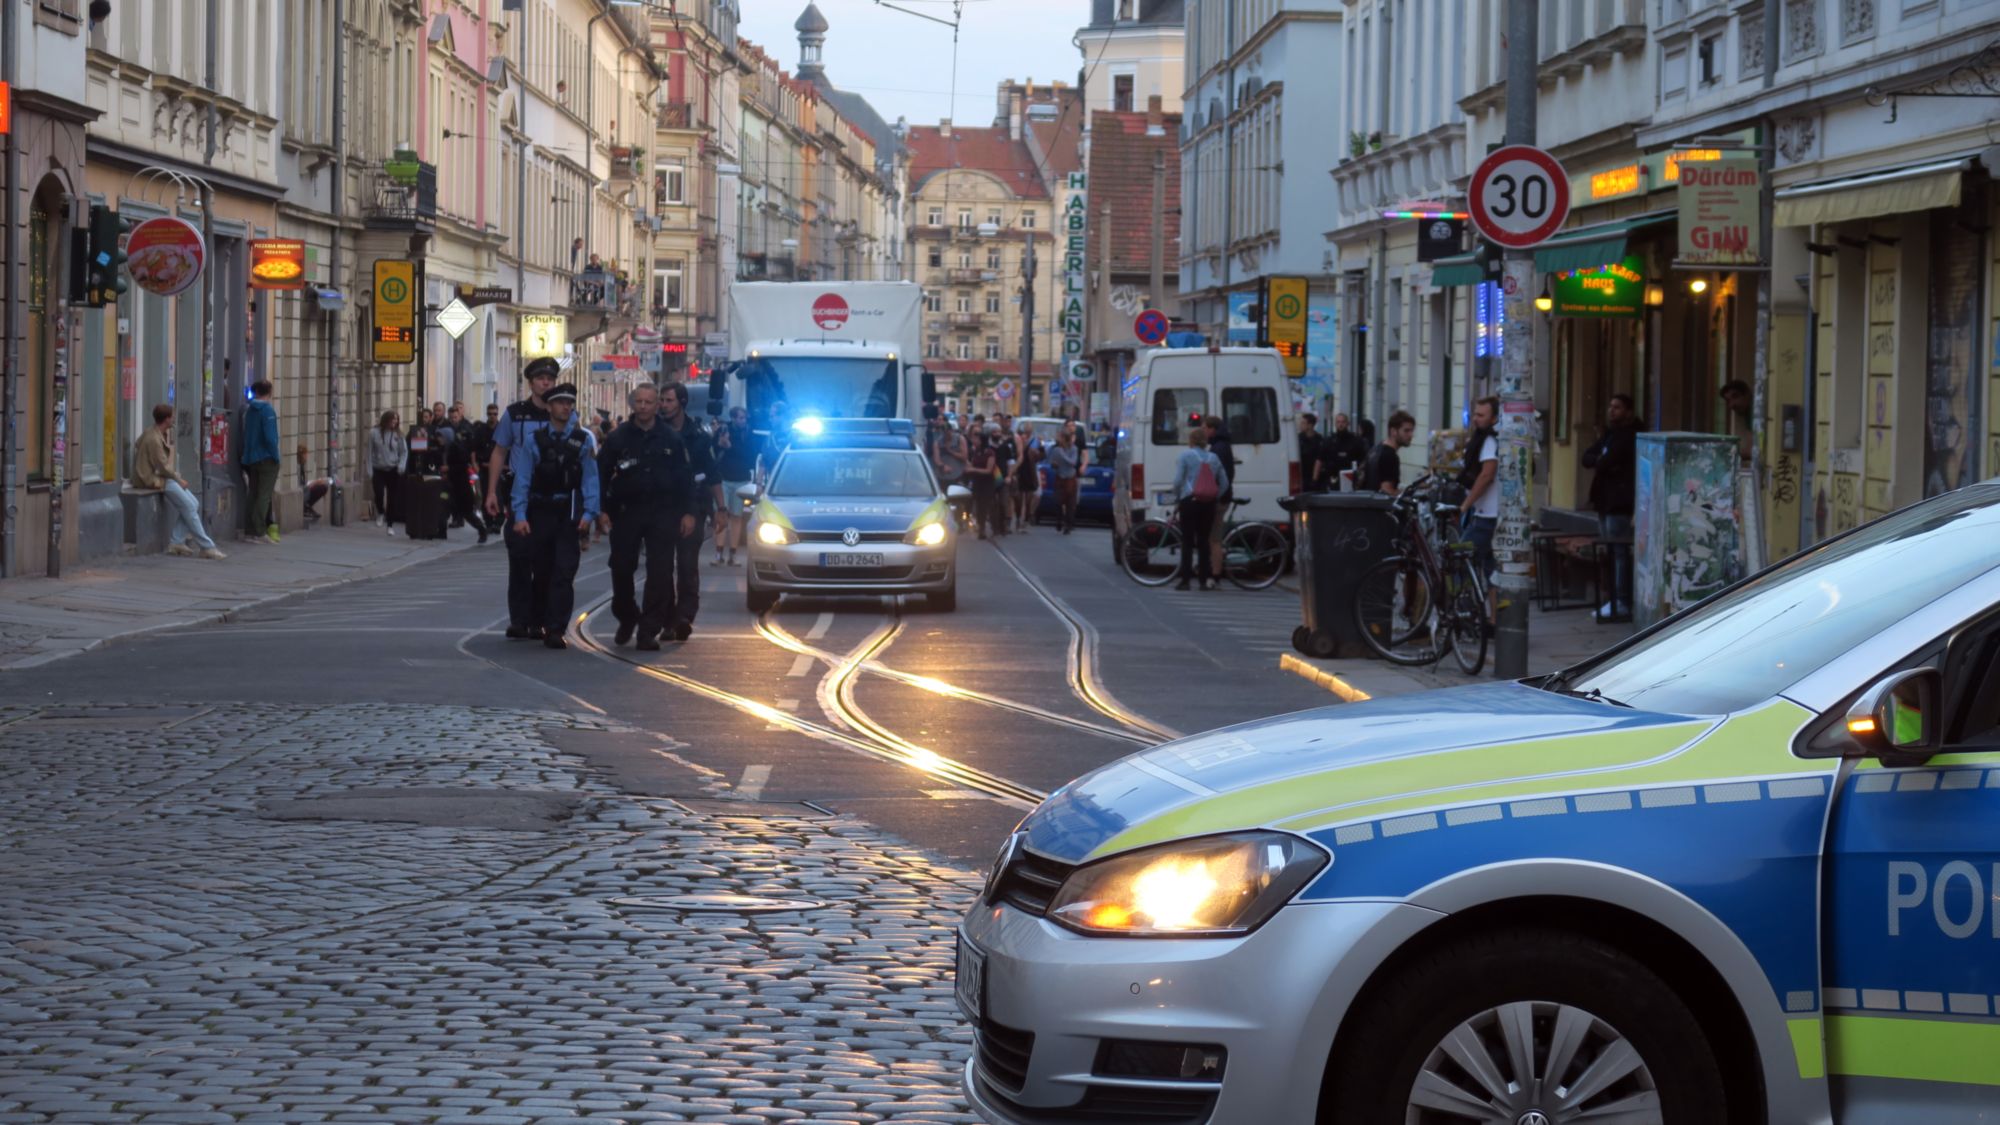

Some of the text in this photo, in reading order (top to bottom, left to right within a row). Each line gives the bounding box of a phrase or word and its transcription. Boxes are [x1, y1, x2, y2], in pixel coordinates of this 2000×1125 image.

[1681, 167, 1757, 187] Dürüm
[1490, 173, 1547, 218] 30
[1066, 173, 1086, 355] HABERLAND
[523, 314, 563, 324] Schuhe
[1333, 525, 1370, 552] 43
[855, 554, 881, 566] 2641
